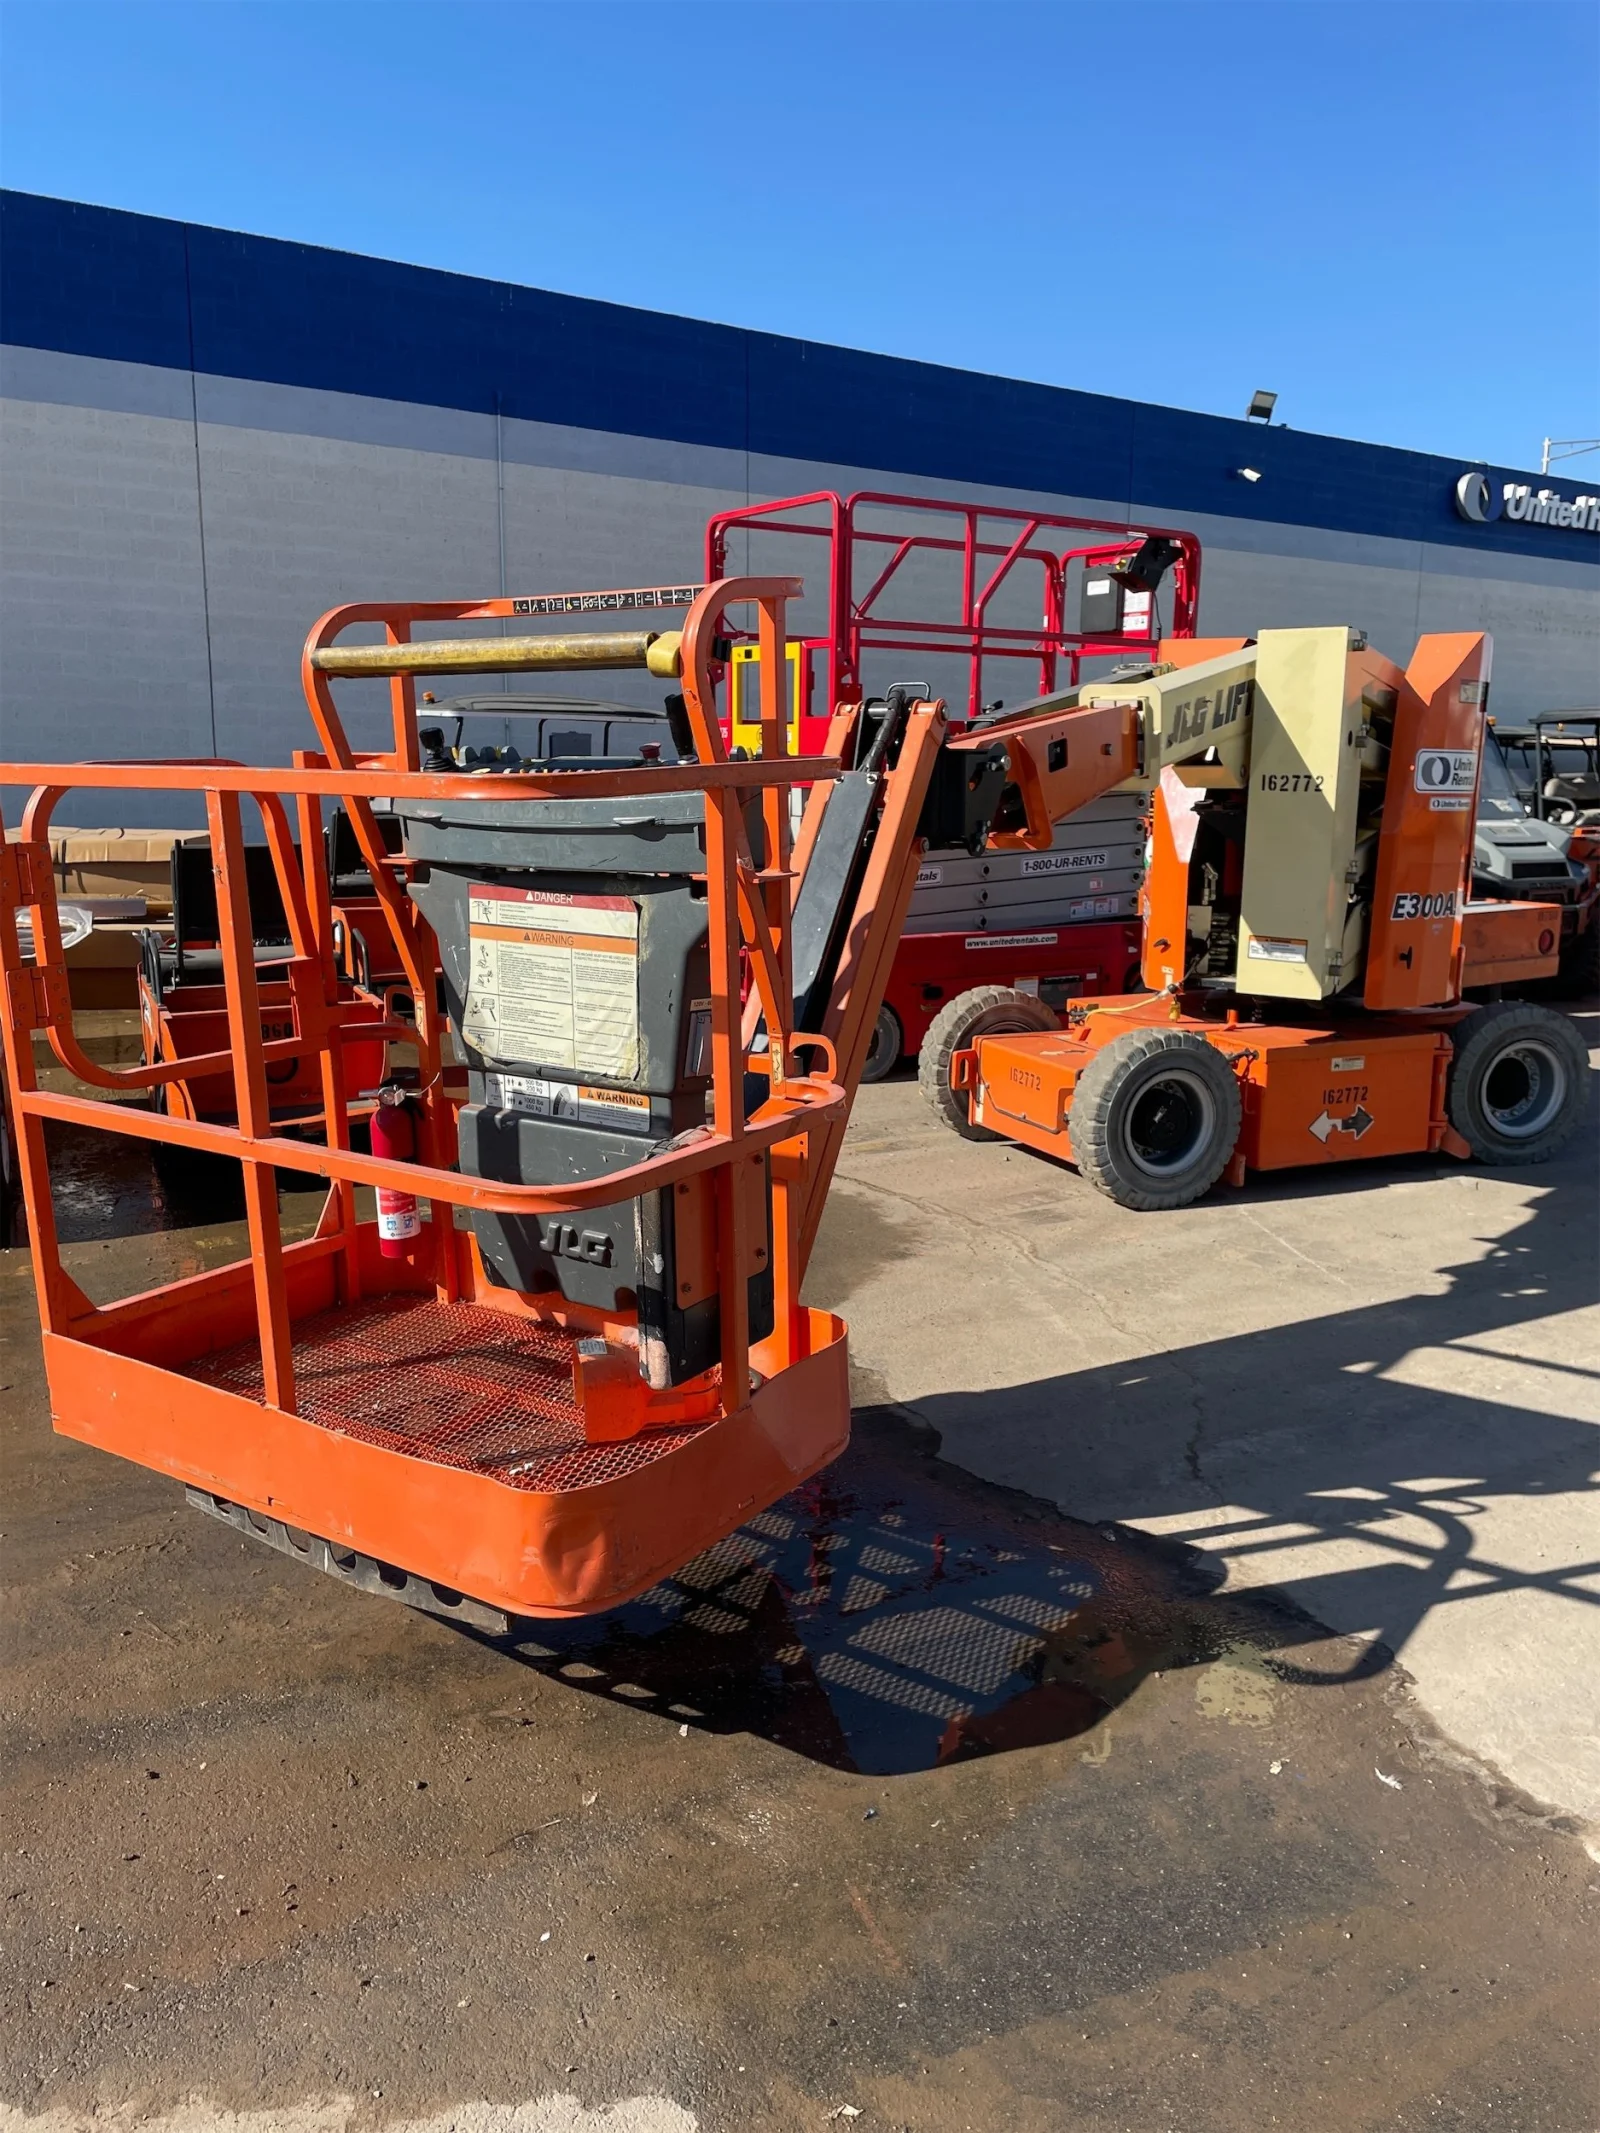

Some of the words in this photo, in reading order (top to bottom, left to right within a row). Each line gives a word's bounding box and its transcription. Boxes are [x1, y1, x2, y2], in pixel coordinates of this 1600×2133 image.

[1503, 483, 1588, 529] United
[1166, 696, 1209, 749] JLG
[1262, 774, 1324, 792] 162772
[1024, 854, 1106, 873] 1-800-UR-RENTS
[534, 892, 573, 905] DANGER
[531, 932, 575, 946] WARNING
[966, 934, 1057, 948] www.unitedrentals.com
[1010, 1066, 1041, 1091] 162772
[596, 1090, 644, 1106] WARNING
[1322, 1086, 1369, 1105] 162772
[539, 1221, 614, 1268] JLG
